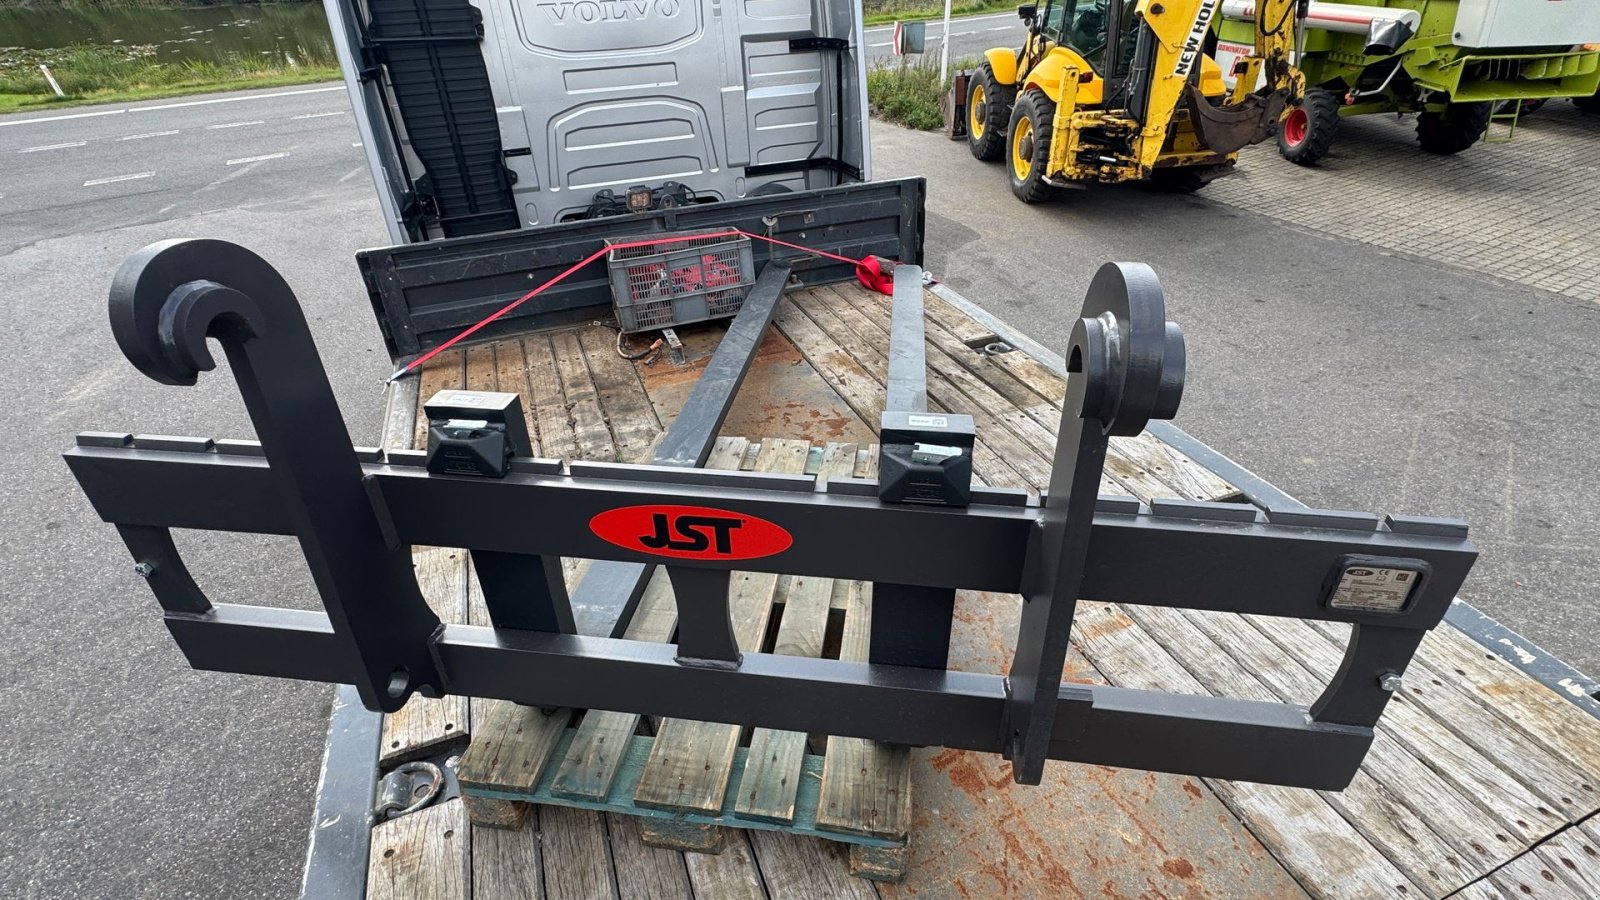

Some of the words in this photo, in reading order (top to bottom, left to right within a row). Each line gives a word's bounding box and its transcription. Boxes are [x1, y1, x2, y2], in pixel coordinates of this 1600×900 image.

[536, 0, 681, 26] VOLVO
[1175, 37, 1199, 75] NEW
[638, 513, 743, 554] JST
